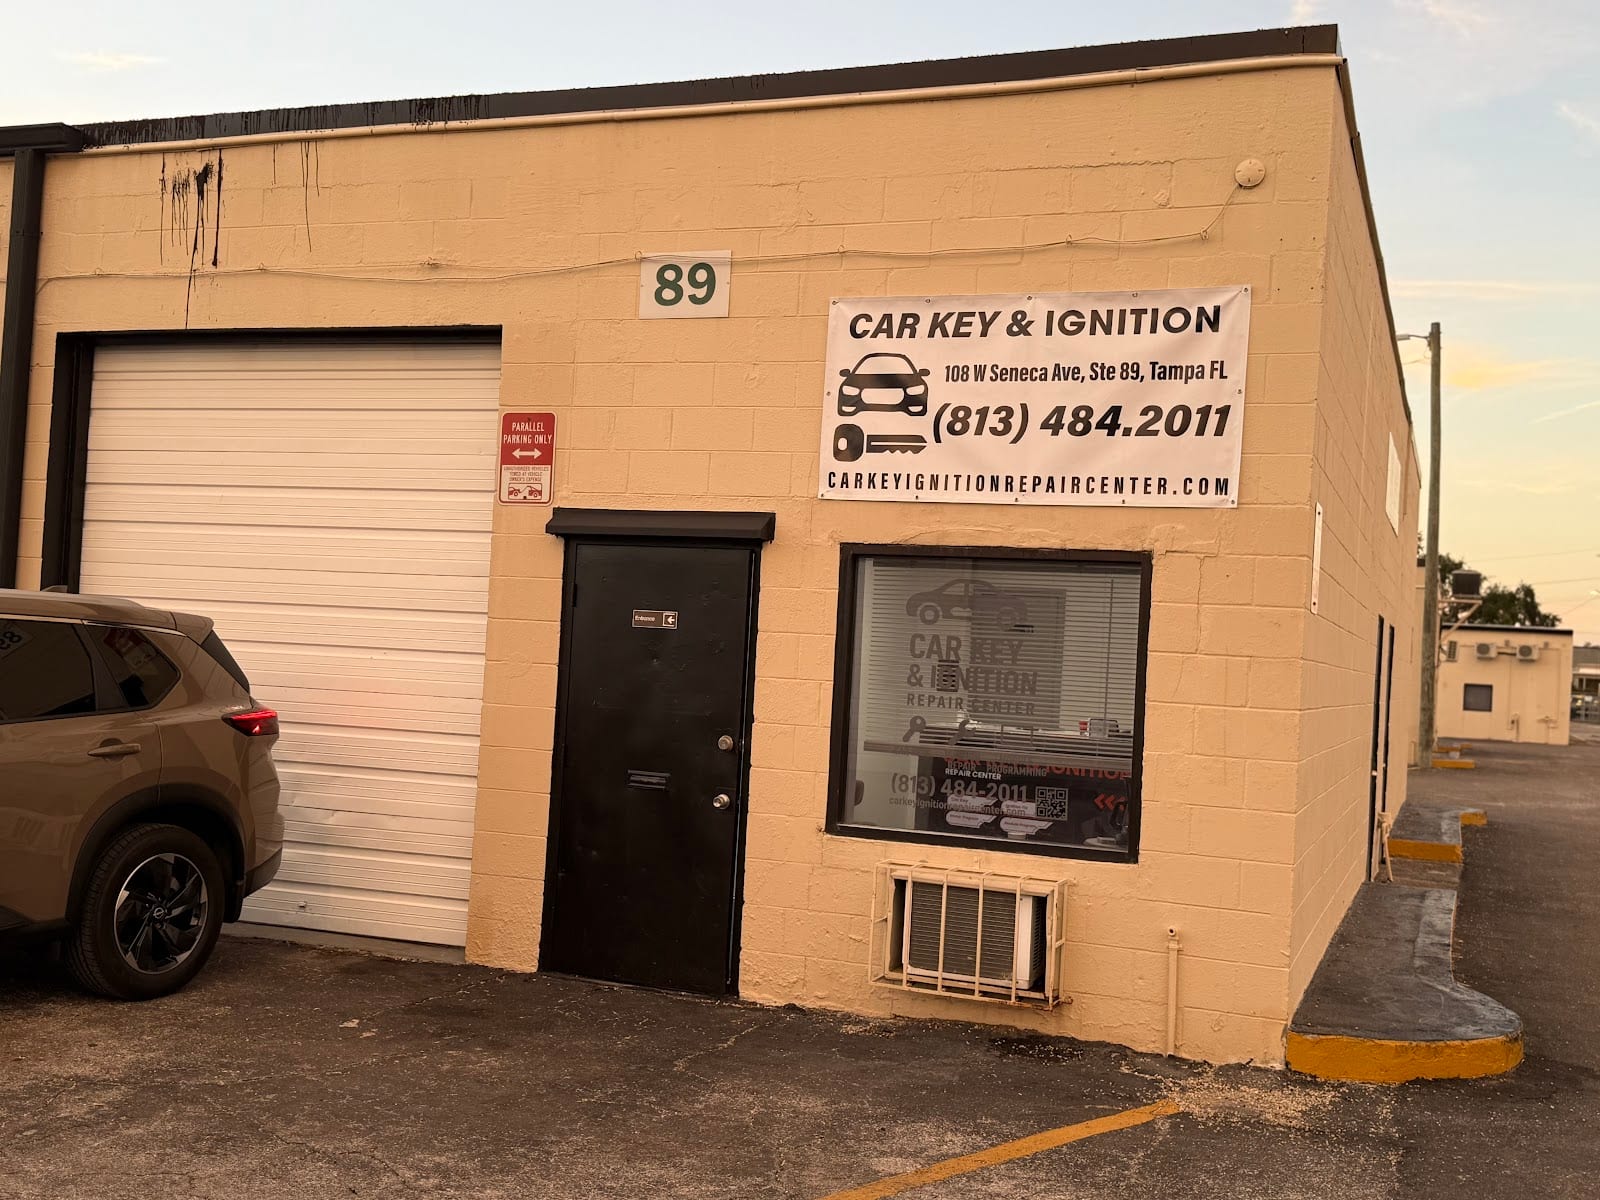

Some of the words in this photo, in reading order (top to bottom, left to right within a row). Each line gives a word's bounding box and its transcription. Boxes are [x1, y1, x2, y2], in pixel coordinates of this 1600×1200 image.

[654, 262, 716, 306] 89
[850, 313, 920, 339] CAR
[927, 311, 1002, 338] KEY
[1005, 310, 1035, 337] &
[1045, 305, 1221, 336] IGNITION
[945, 364, 969, 382] 108
[974, 364, 986, 382] W
[989, 363, 1048, 382] Seneca
[1051, 363, 1085, 383] Ave,
[1089, 362, 1116, 381] Ste
[1120, 362, 1145, 383] 89,
[1149, 361, 1205, 384] Tampa
[1209, 360, 1228, 380] FL
[511, 422, 545, 432] PARALLEL
[933, 402, 1029, 444] (813)
[1039, 404, 1231, 437] 484.2011
[503, 434, 532, 444] PARKING
[534, 434, 552, 444] ONLY
[828, 471, 1229, 496] CARKEYIGNITIONREPAIRCENTER.COM
[909, 633, 962, 661] CAR
[969, 638, 1024, 665] KEY
[906, 663, 924, 688] &
[930, 664, 1038, 696] IGNITION
[906, 692, 964, 710] REPAIR
[970, 699, 1036, 716] CENTER
[891, 772, 936, 797] (813)
[940, 778, 1028, 802] 484-2011
[945, 767, 971, 778] REPAIR
[971, 770, 1002, 781] CENTER
